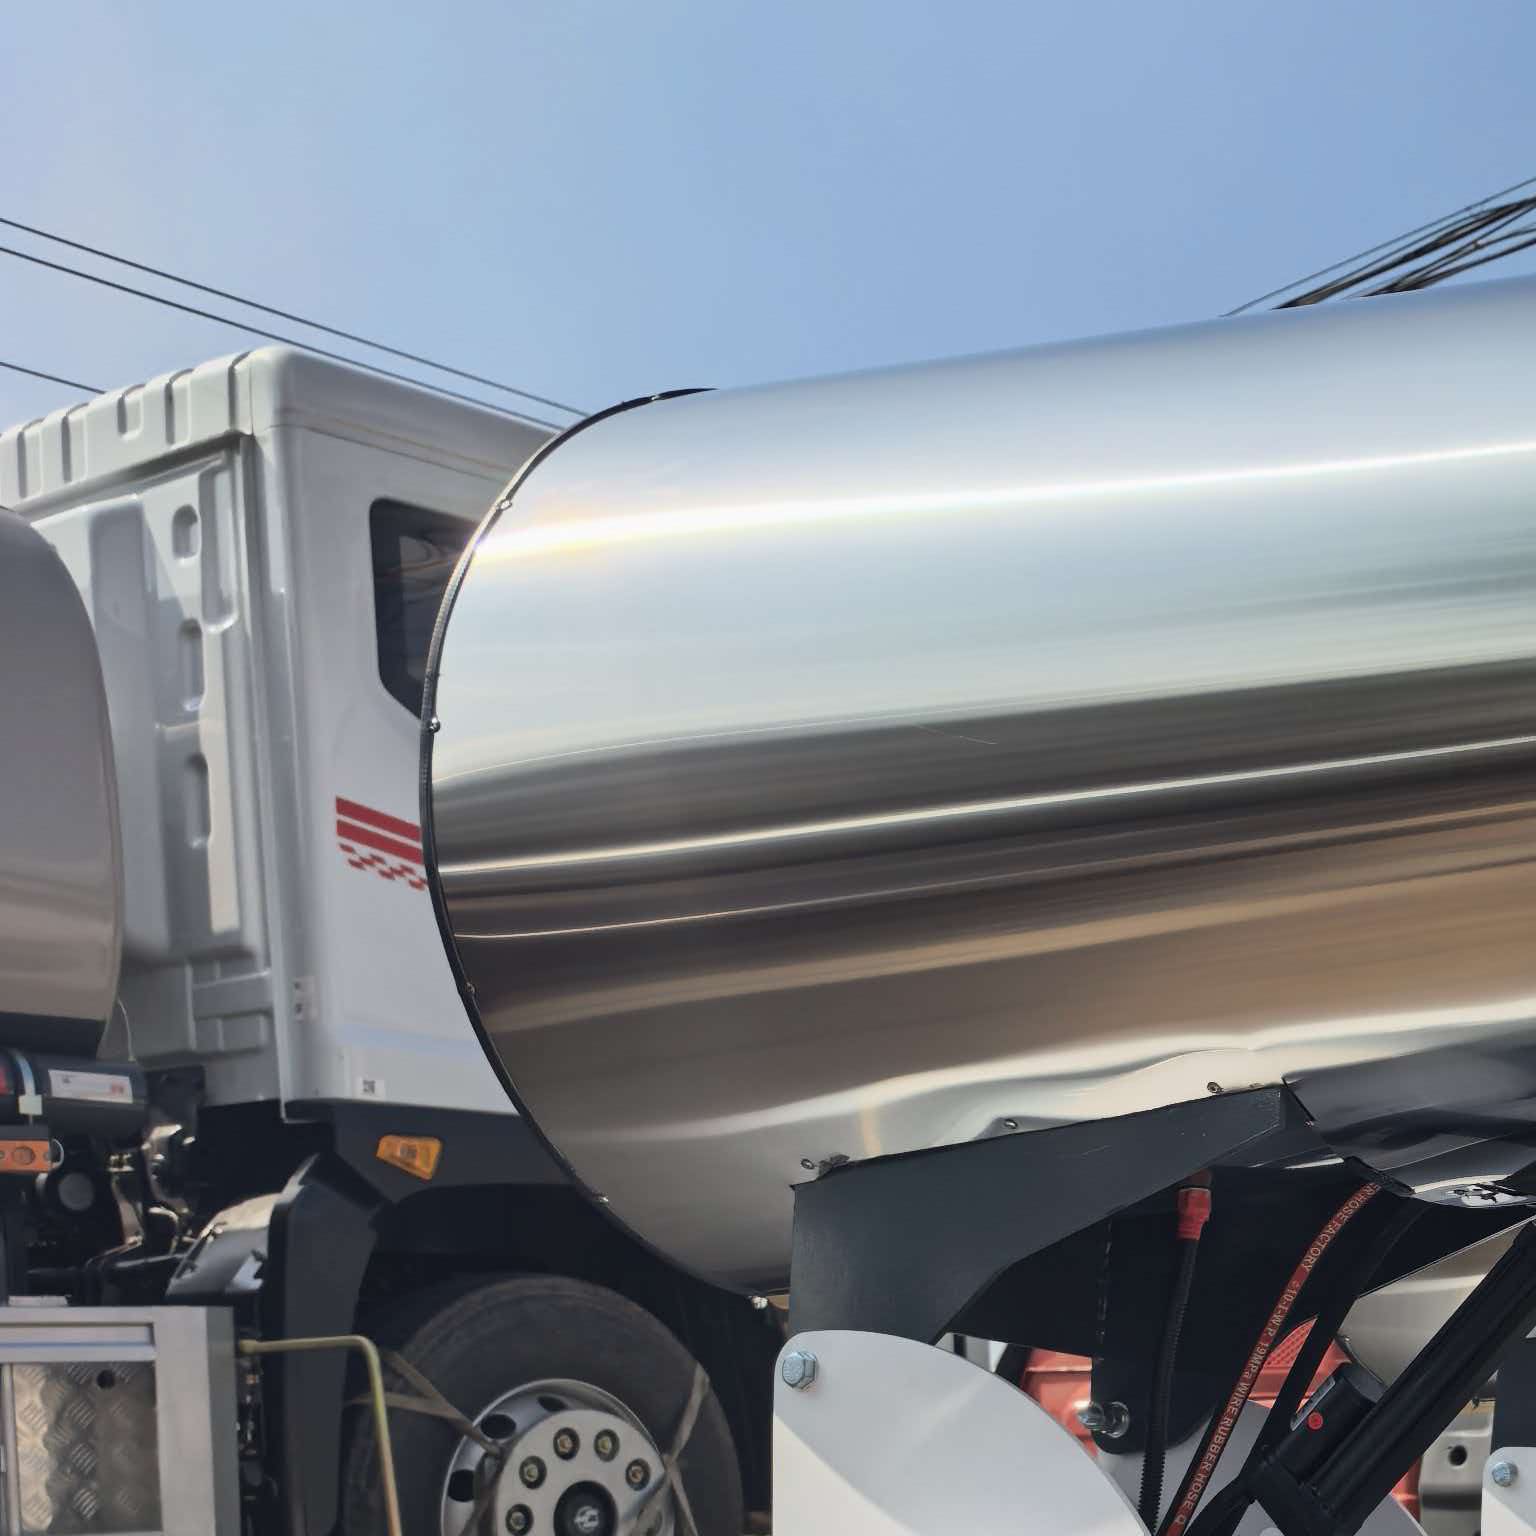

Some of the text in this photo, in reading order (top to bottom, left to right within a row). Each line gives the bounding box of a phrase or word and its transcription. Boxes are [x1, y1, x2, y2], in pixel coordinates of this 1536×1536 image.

[1302, 1219, 1343, 1271] FACTORY
[1228, 1382, 1250, 1415] WIRE
[1201, 1416, 1233, 1471] RUBBER
[1184, 1472, 1207, 1509] HOSE
